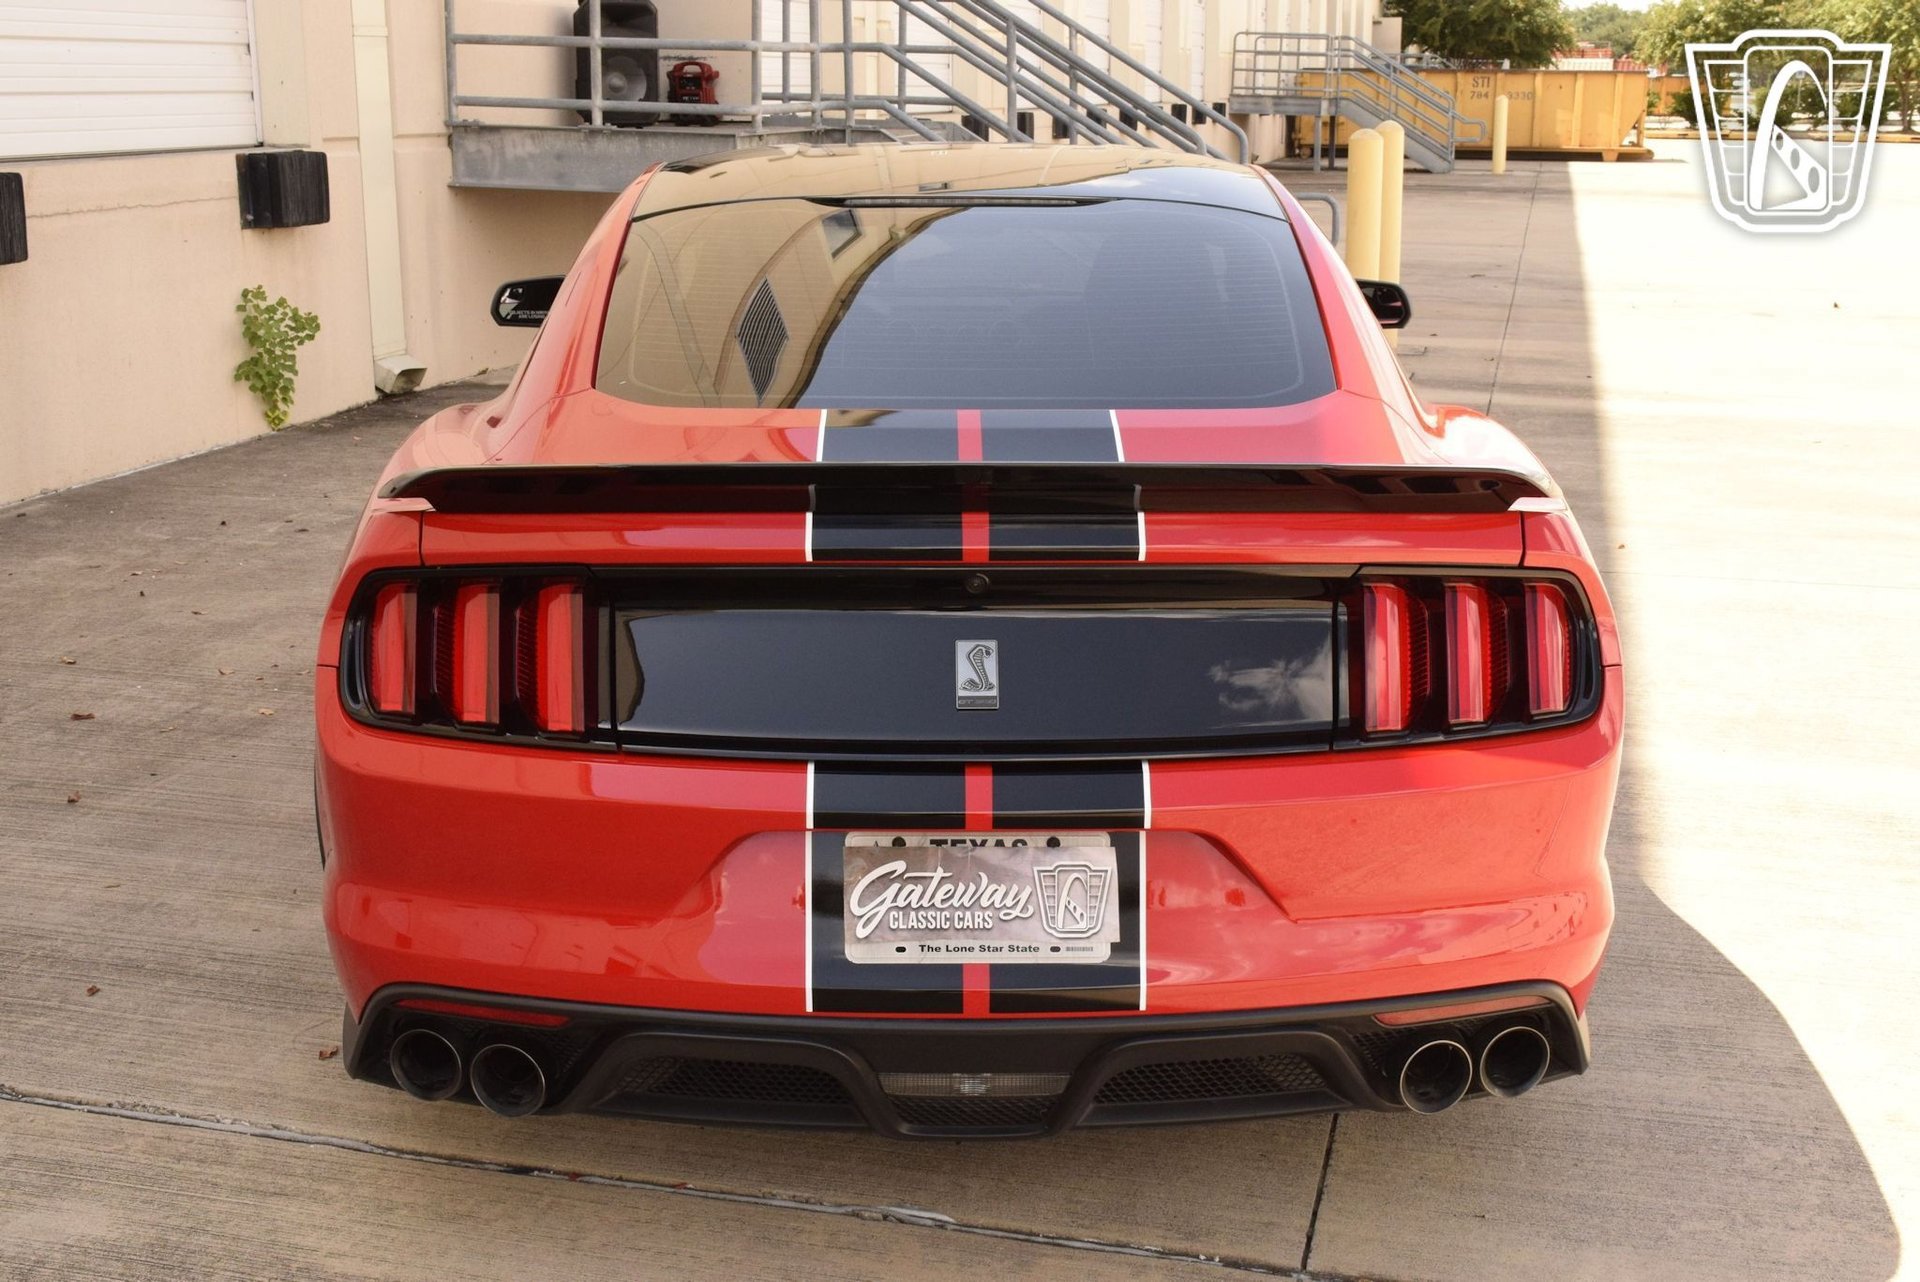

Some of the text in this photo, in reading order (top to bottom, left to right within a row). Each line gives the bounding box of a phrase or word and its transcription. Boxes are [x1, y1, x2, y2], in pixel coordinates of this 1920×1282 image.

[850, 860, 1034, 939] Gateway
[889, 911, 993, 929] CLASSIC CARS
[919, 945, 1040, 953] The Lone Star State
